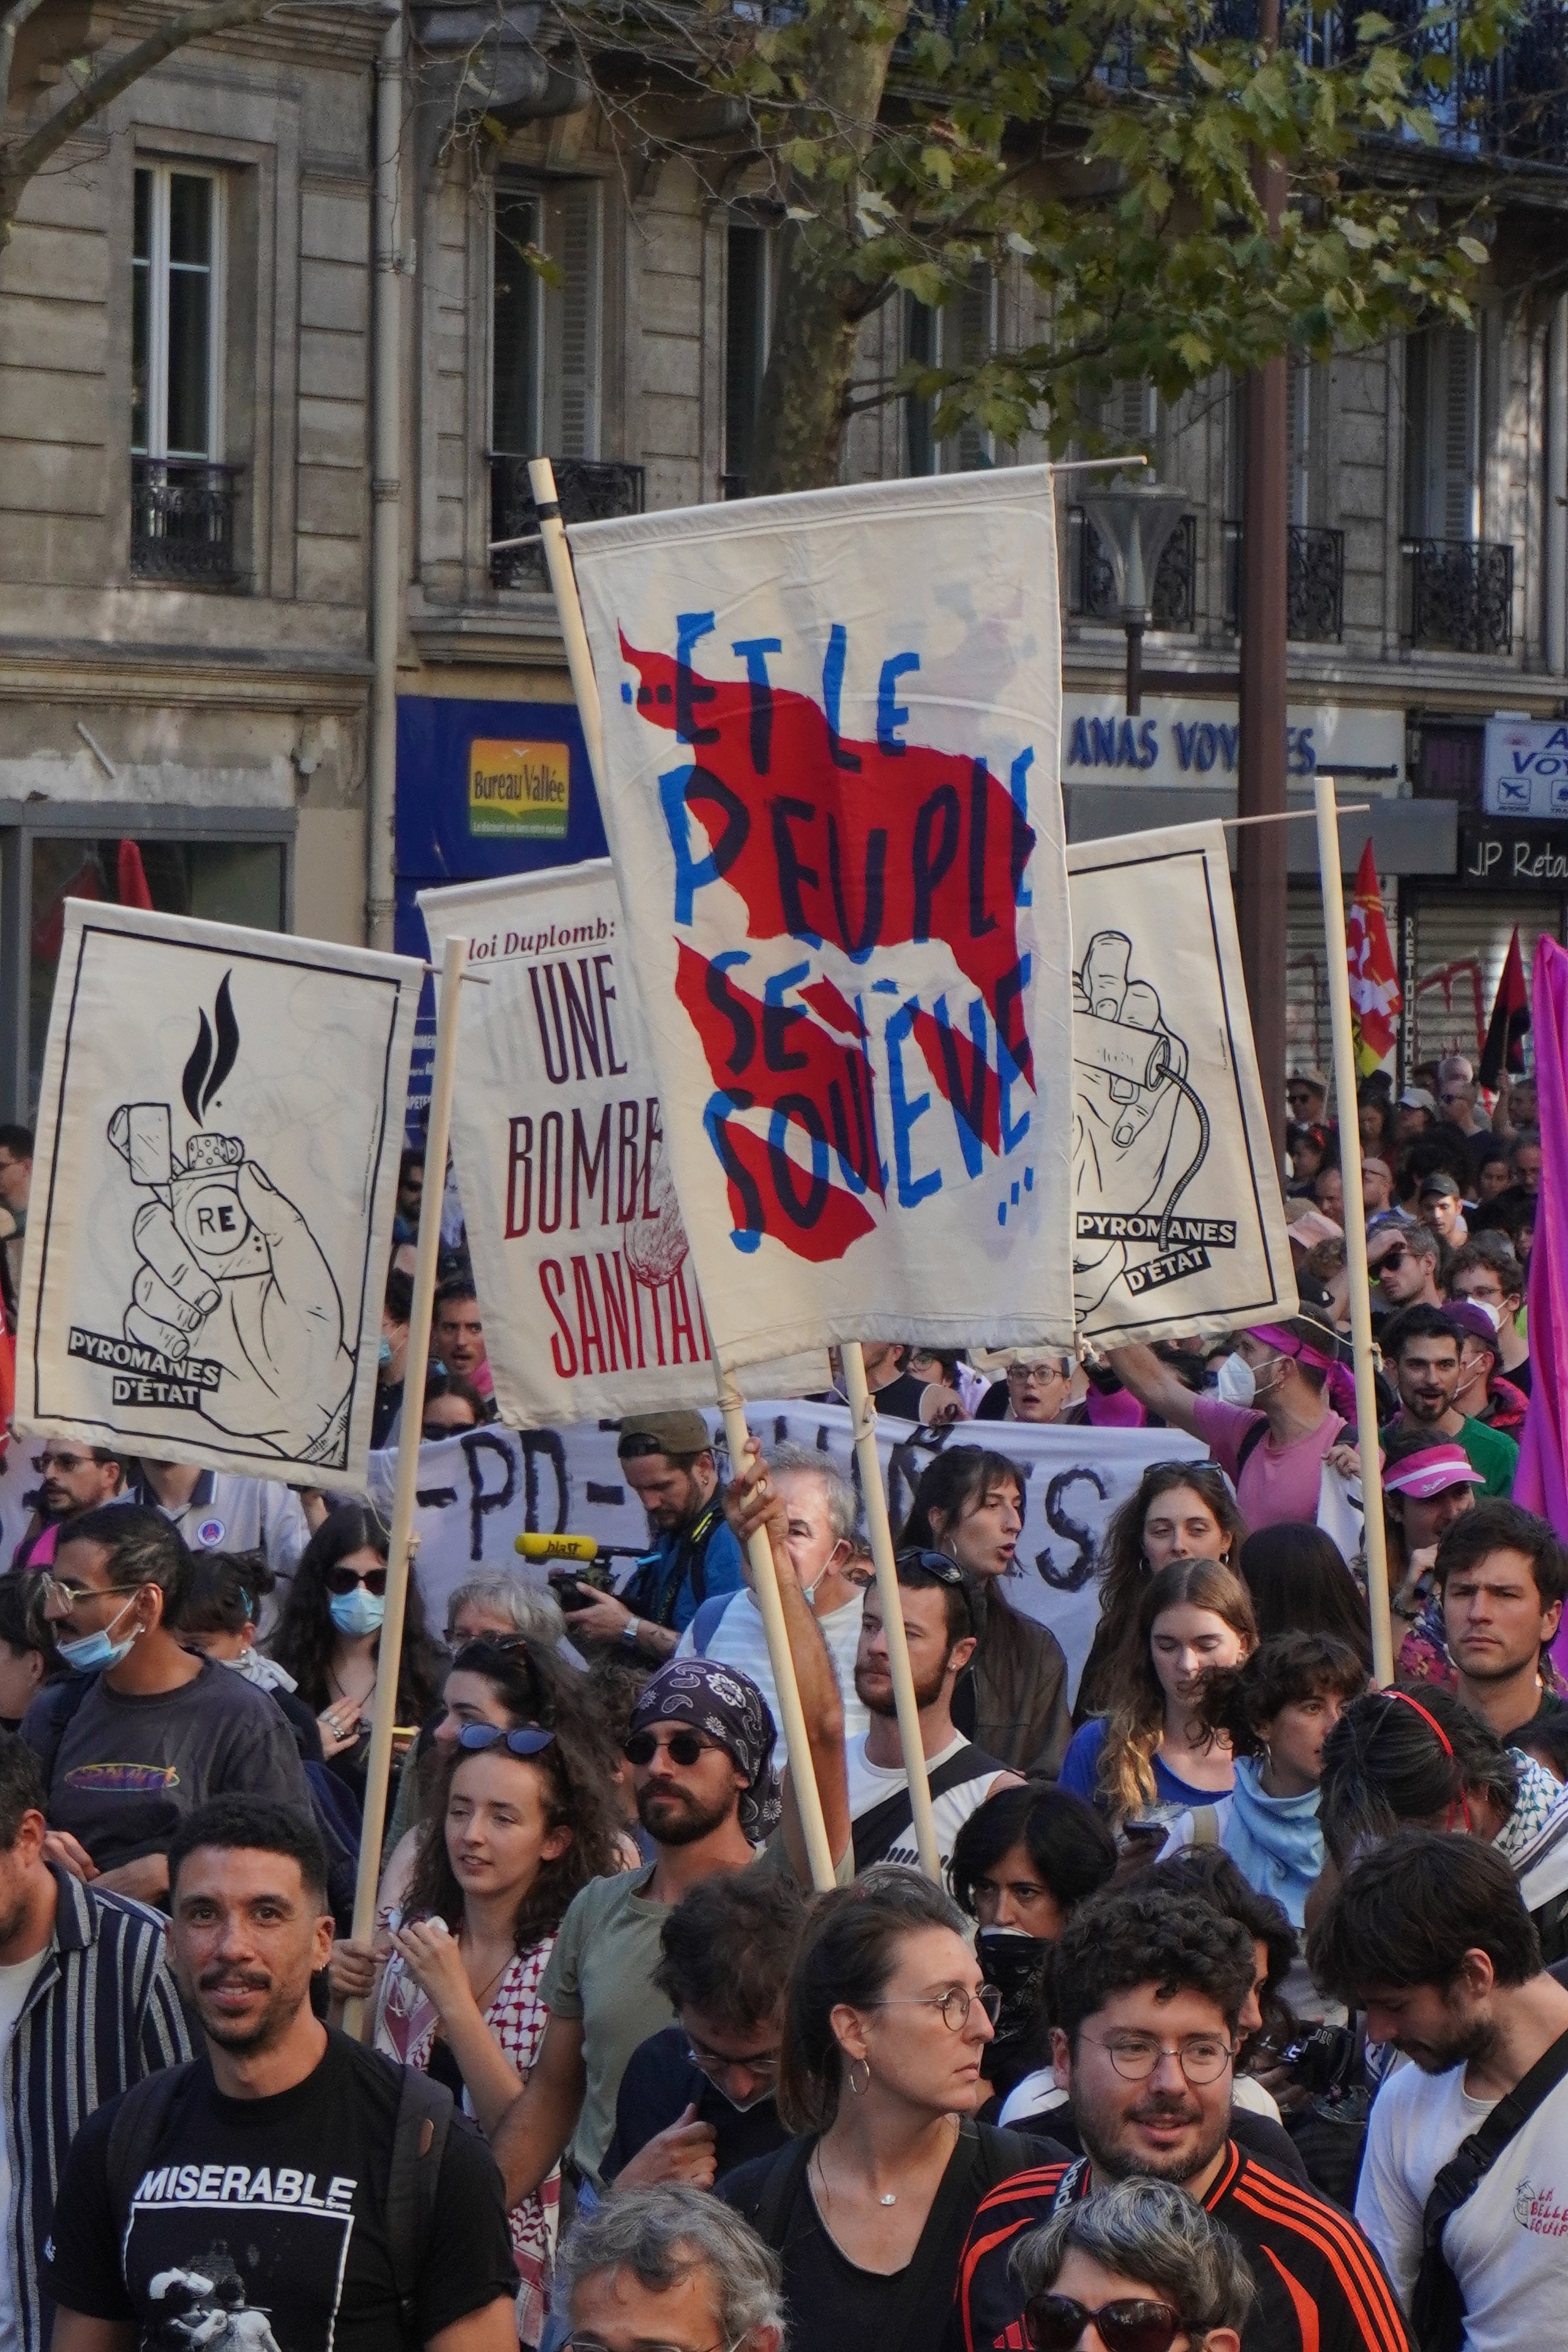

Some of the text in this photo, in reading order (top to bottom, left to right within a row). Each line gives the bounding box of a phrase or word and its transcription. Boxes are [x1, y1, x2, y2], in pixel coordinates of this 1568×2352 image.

[822, 623, 921, 775] LE
[1067, 716, 1317, 776] ANAS VOYES
[475, 763, 565, 803] Bureau Vallée
[658, 745, 1037, 965] PEUPLE
[468, 917, 615, 961] loi Duplomb:
[528, 954, 628, 1084] UNE
[706, 950, 810, 1077] SE
[504, 1097, 664, 1239] BOMBE
[198, 1205, 236, 1236] RE
[1077, 1215, 1236, 1244] PYROMANES
[1126, 1246, 1205, 1291] D'ÉTAT
[69, 1330, 221, 1386] PYROMANES
[114, 1376, 199, 1406] D'ÉTAT
[133, 2164, 359, 2213] MISERABLE
[1530, 2201, 1568, 2222] BELLE
[1539, 2188, 1554, 2202] LA
